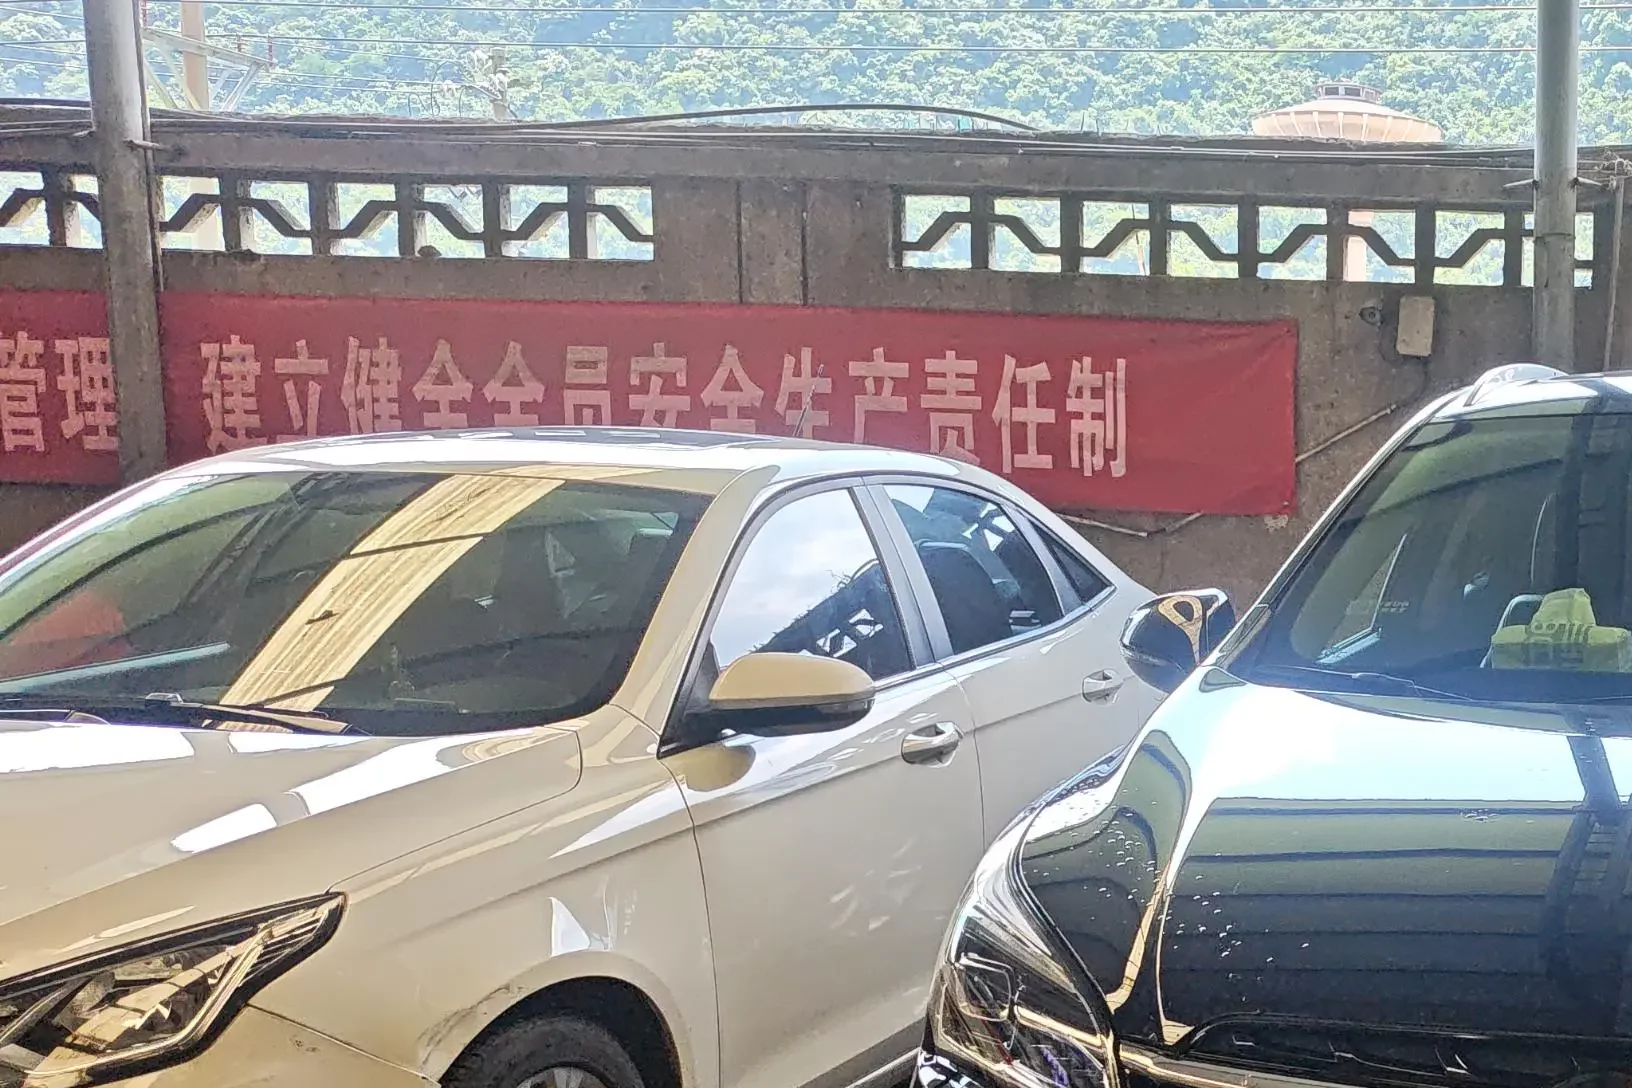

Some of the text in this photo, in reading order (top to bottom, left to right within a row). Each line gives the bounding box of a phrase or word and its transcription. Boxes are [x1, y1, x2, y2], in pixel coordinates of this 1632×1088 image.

[0, 330, 1127, 477] 管理 建立健全全员安全生产责任制
